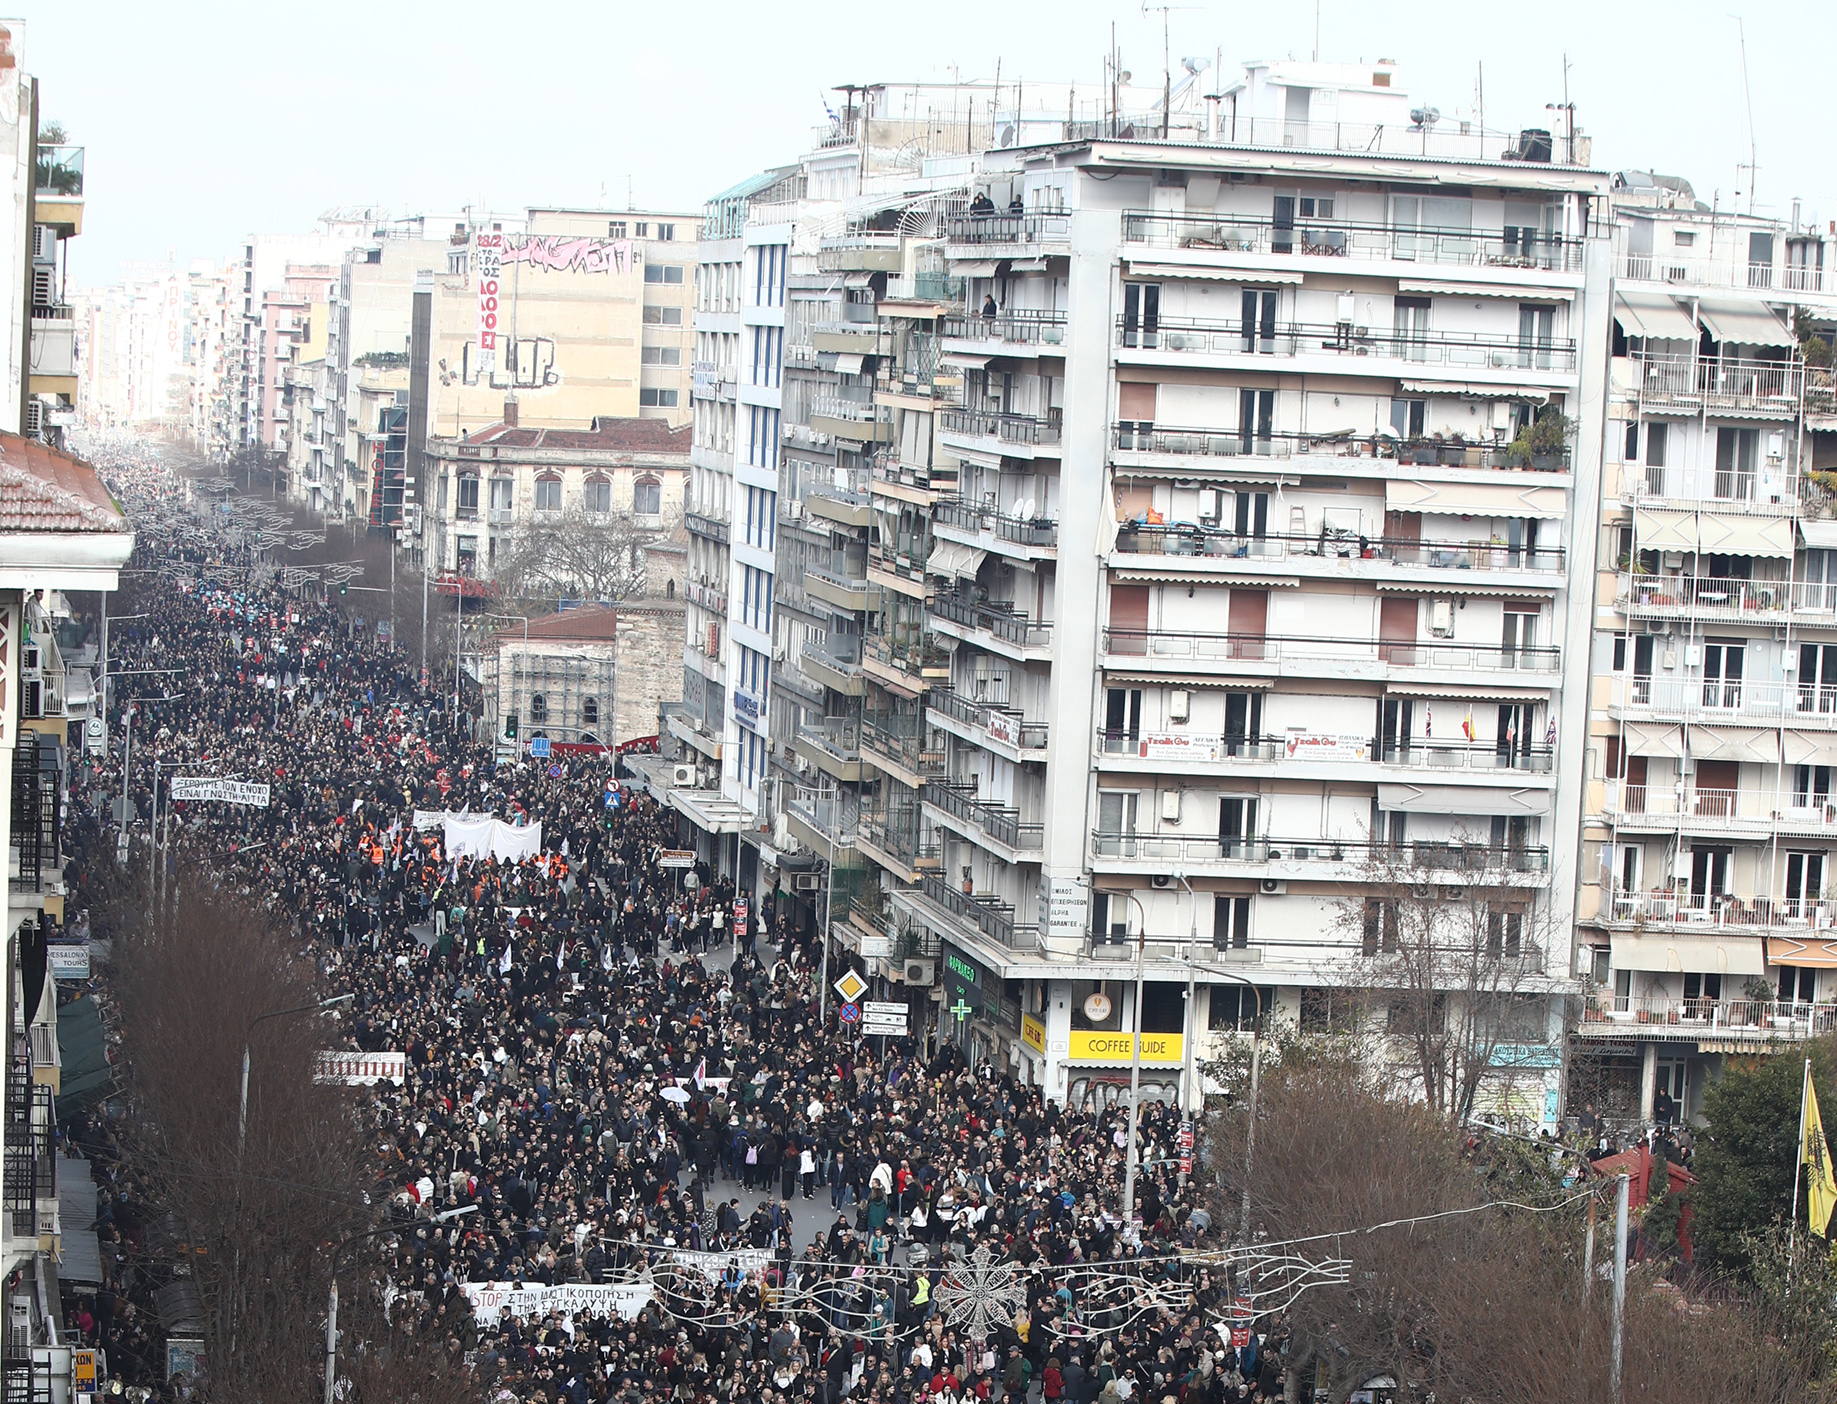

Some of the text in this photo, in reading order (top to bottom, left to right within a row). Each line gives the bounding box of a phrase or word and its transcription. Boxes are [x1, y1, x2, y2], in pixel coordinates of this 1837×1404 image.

[371, 441, 384, 526] HOTEL
[1088, 1040, 1130, 1053] COFFEE
[474, 1293, 503, 1308] STOP
[508, 1293, 537, 1304] ΣΤΗΝ
